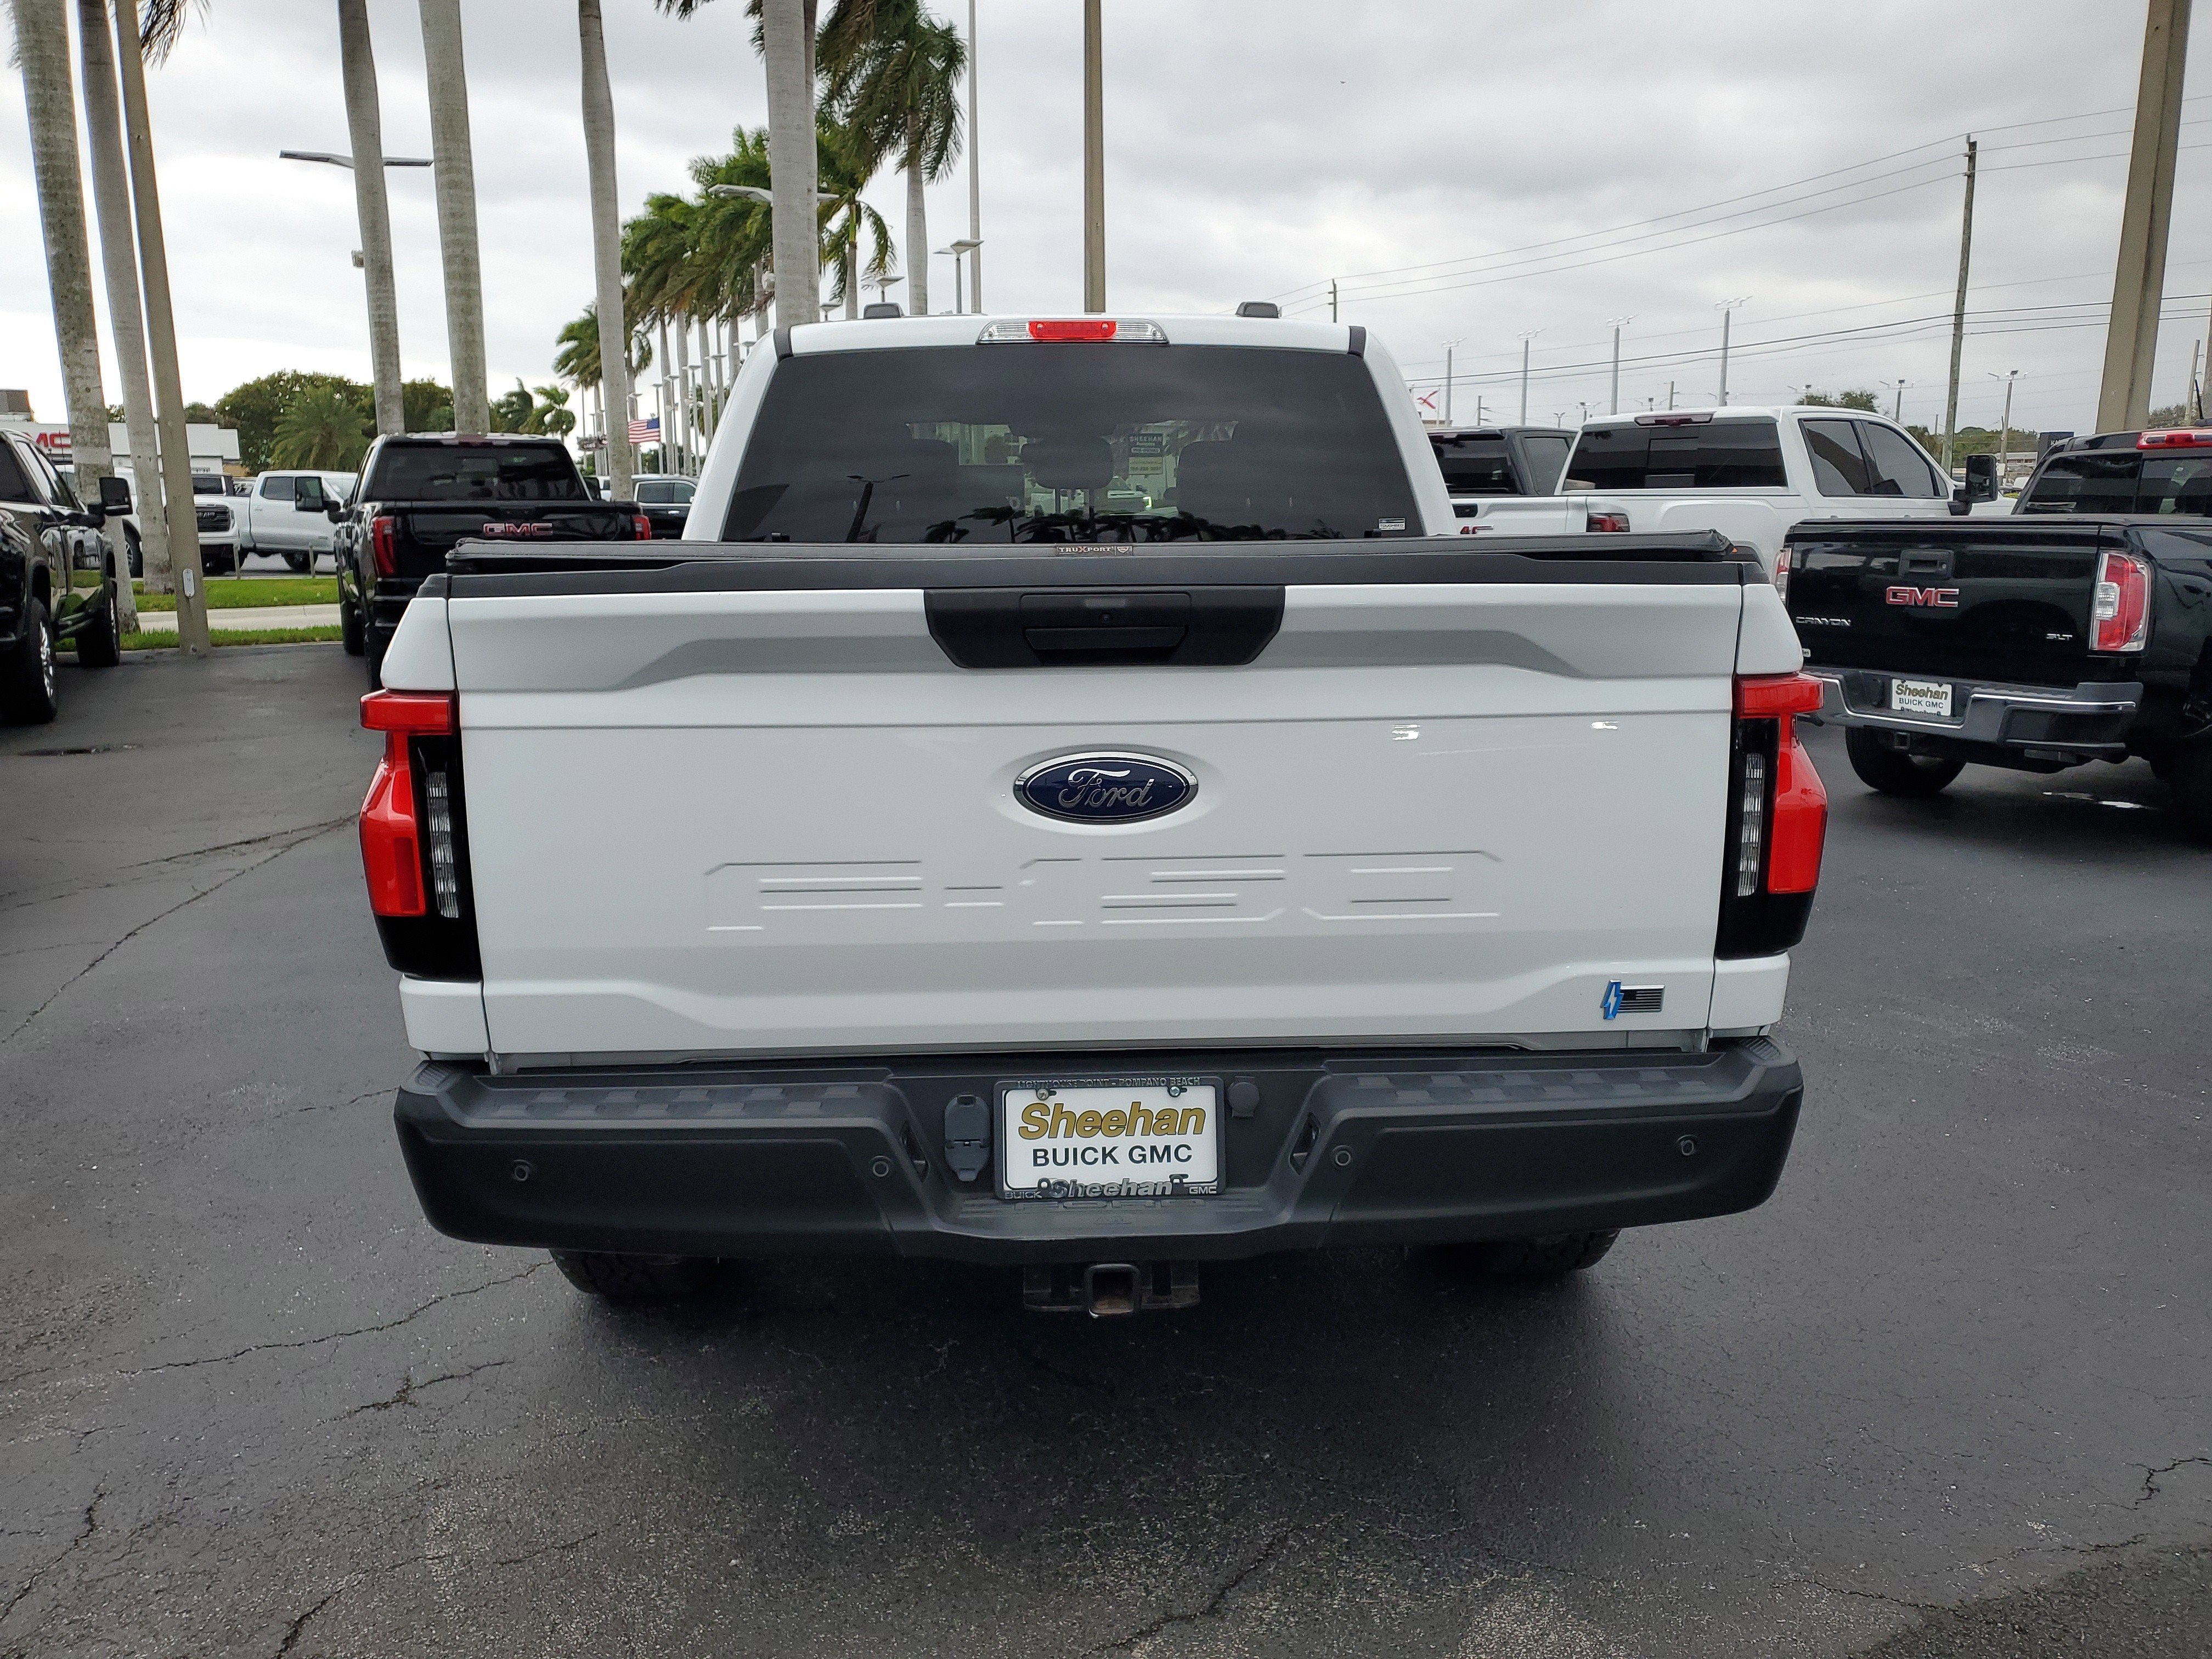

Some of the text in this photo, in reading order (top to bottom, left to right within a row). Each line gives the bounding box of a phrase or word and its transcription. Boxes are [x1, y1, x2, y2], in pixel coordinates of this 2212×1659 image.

[24, 432, 71, 448] MC
[483, 523, 553, 537] GMC
[1886, 586, 1959, 607] GMC
[1796, 617, 1851, 626] CANYON
[1895, 684, 1948, 700] Sheehan
[1899, 698, 1923, 706] BUICK
[1058, 769, 1155, 809] Ford
[1119, 1077, 1167, 1086] POMPANO
[1170, 1077, 1200, 1085] BEACH
[1019, 1102, 1206, 1140] Sheehan
[1032, 1144, 1192, 1167] BUICK GMC
[1005, 1178, 1217, 1199] BUICK Sheehan GMC
